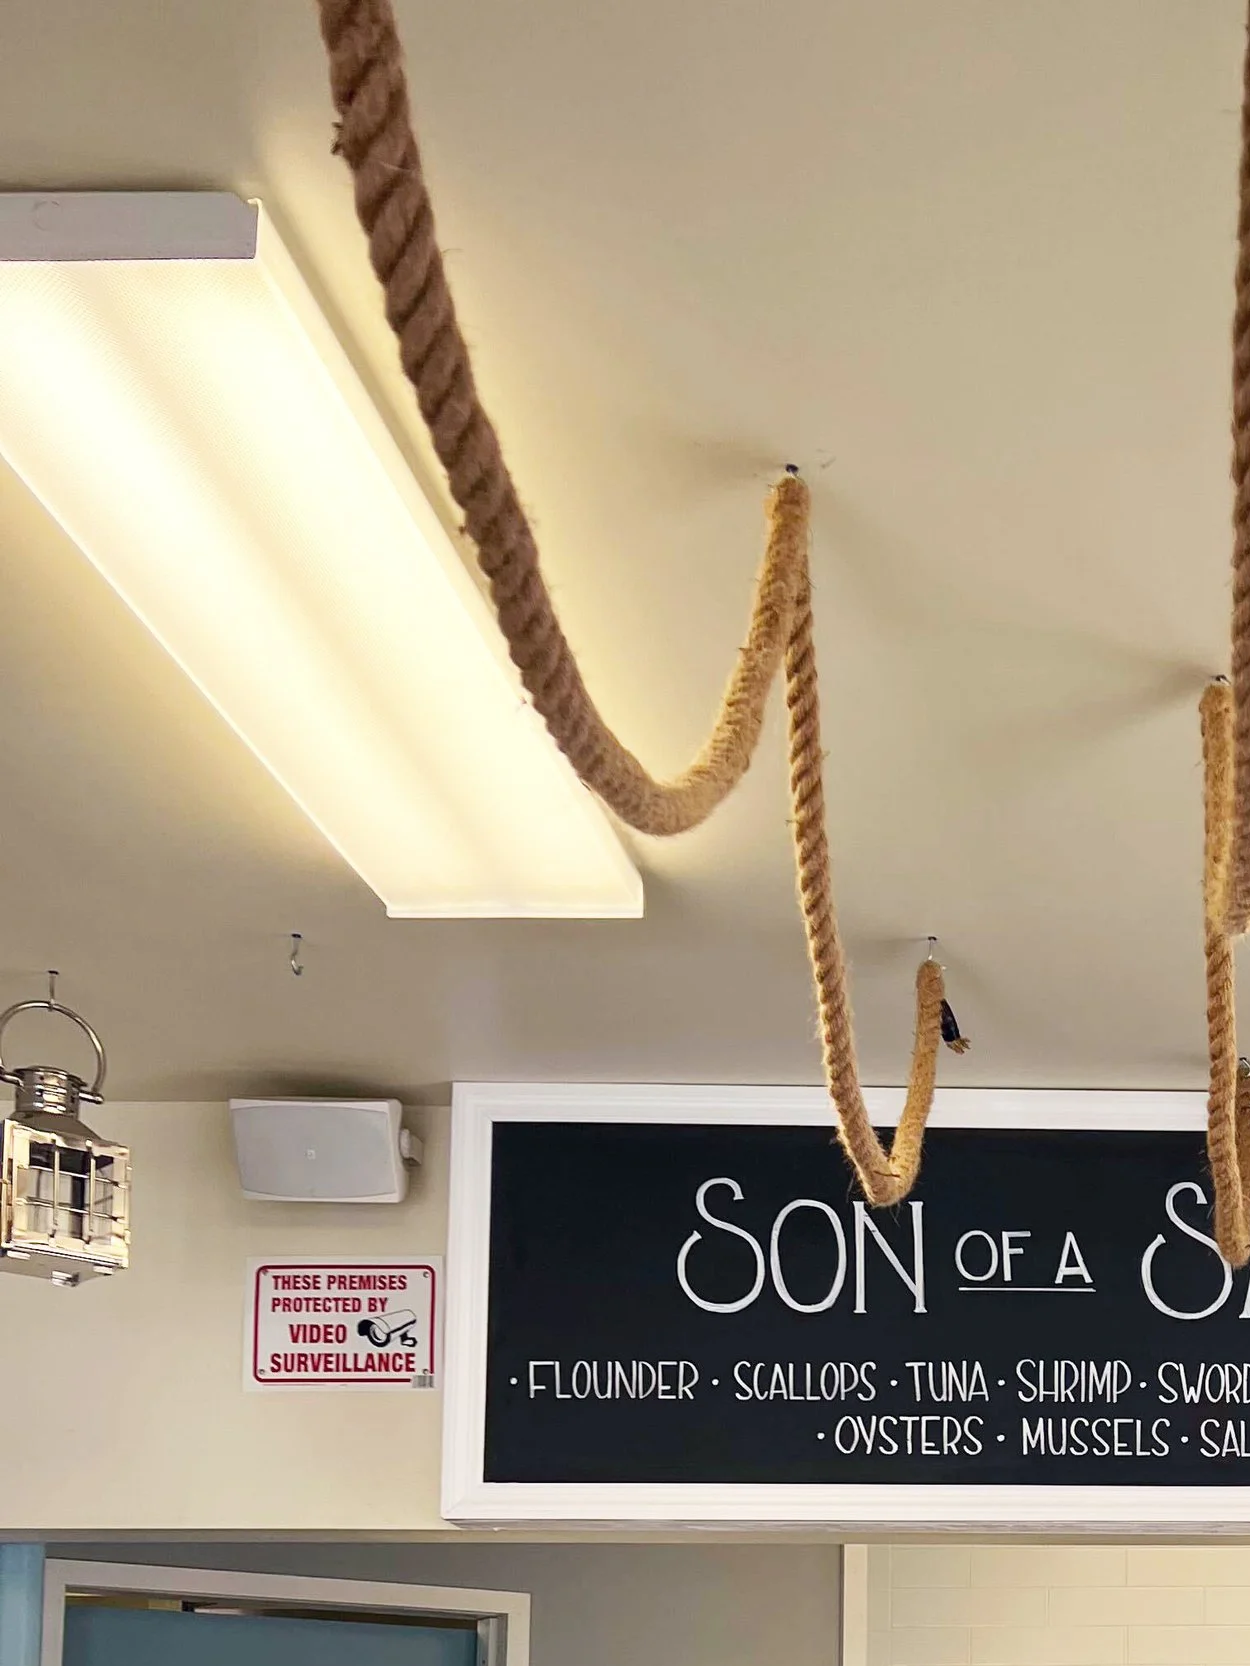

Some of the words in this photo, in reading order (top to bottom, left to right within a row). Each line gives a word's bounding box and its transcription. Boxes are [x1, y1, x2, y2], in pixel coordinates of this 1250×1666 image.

[676, 1177, 928, 1314] SON
[954, 1229, 1032, 1283] OF
[1054, 1231, 1094, 1285] A
[271, 1275, 321, 1291] THESE
[326, 1275, 408, 1291] PREMISES
[271, 1297, 362, 1313] PROTECTED
[367, 1297, 389, 1313] BY
[288, 1324, 348, 1344] VIDEO
[270, 1352, 417, 1374] SURVEILLANCE
[528, 1360, 699, 1400] FLOUNDER
[733, 1360, 877, 1402] SCALLOPS
[904, 1360, 990, 1402] TUNA
[1015, 1358, 1132, 1404] SHRIMP
[834, 1415, 984, 1456] OYSTERS
[1022, 1417, 1171, 1457] MUSSELS
